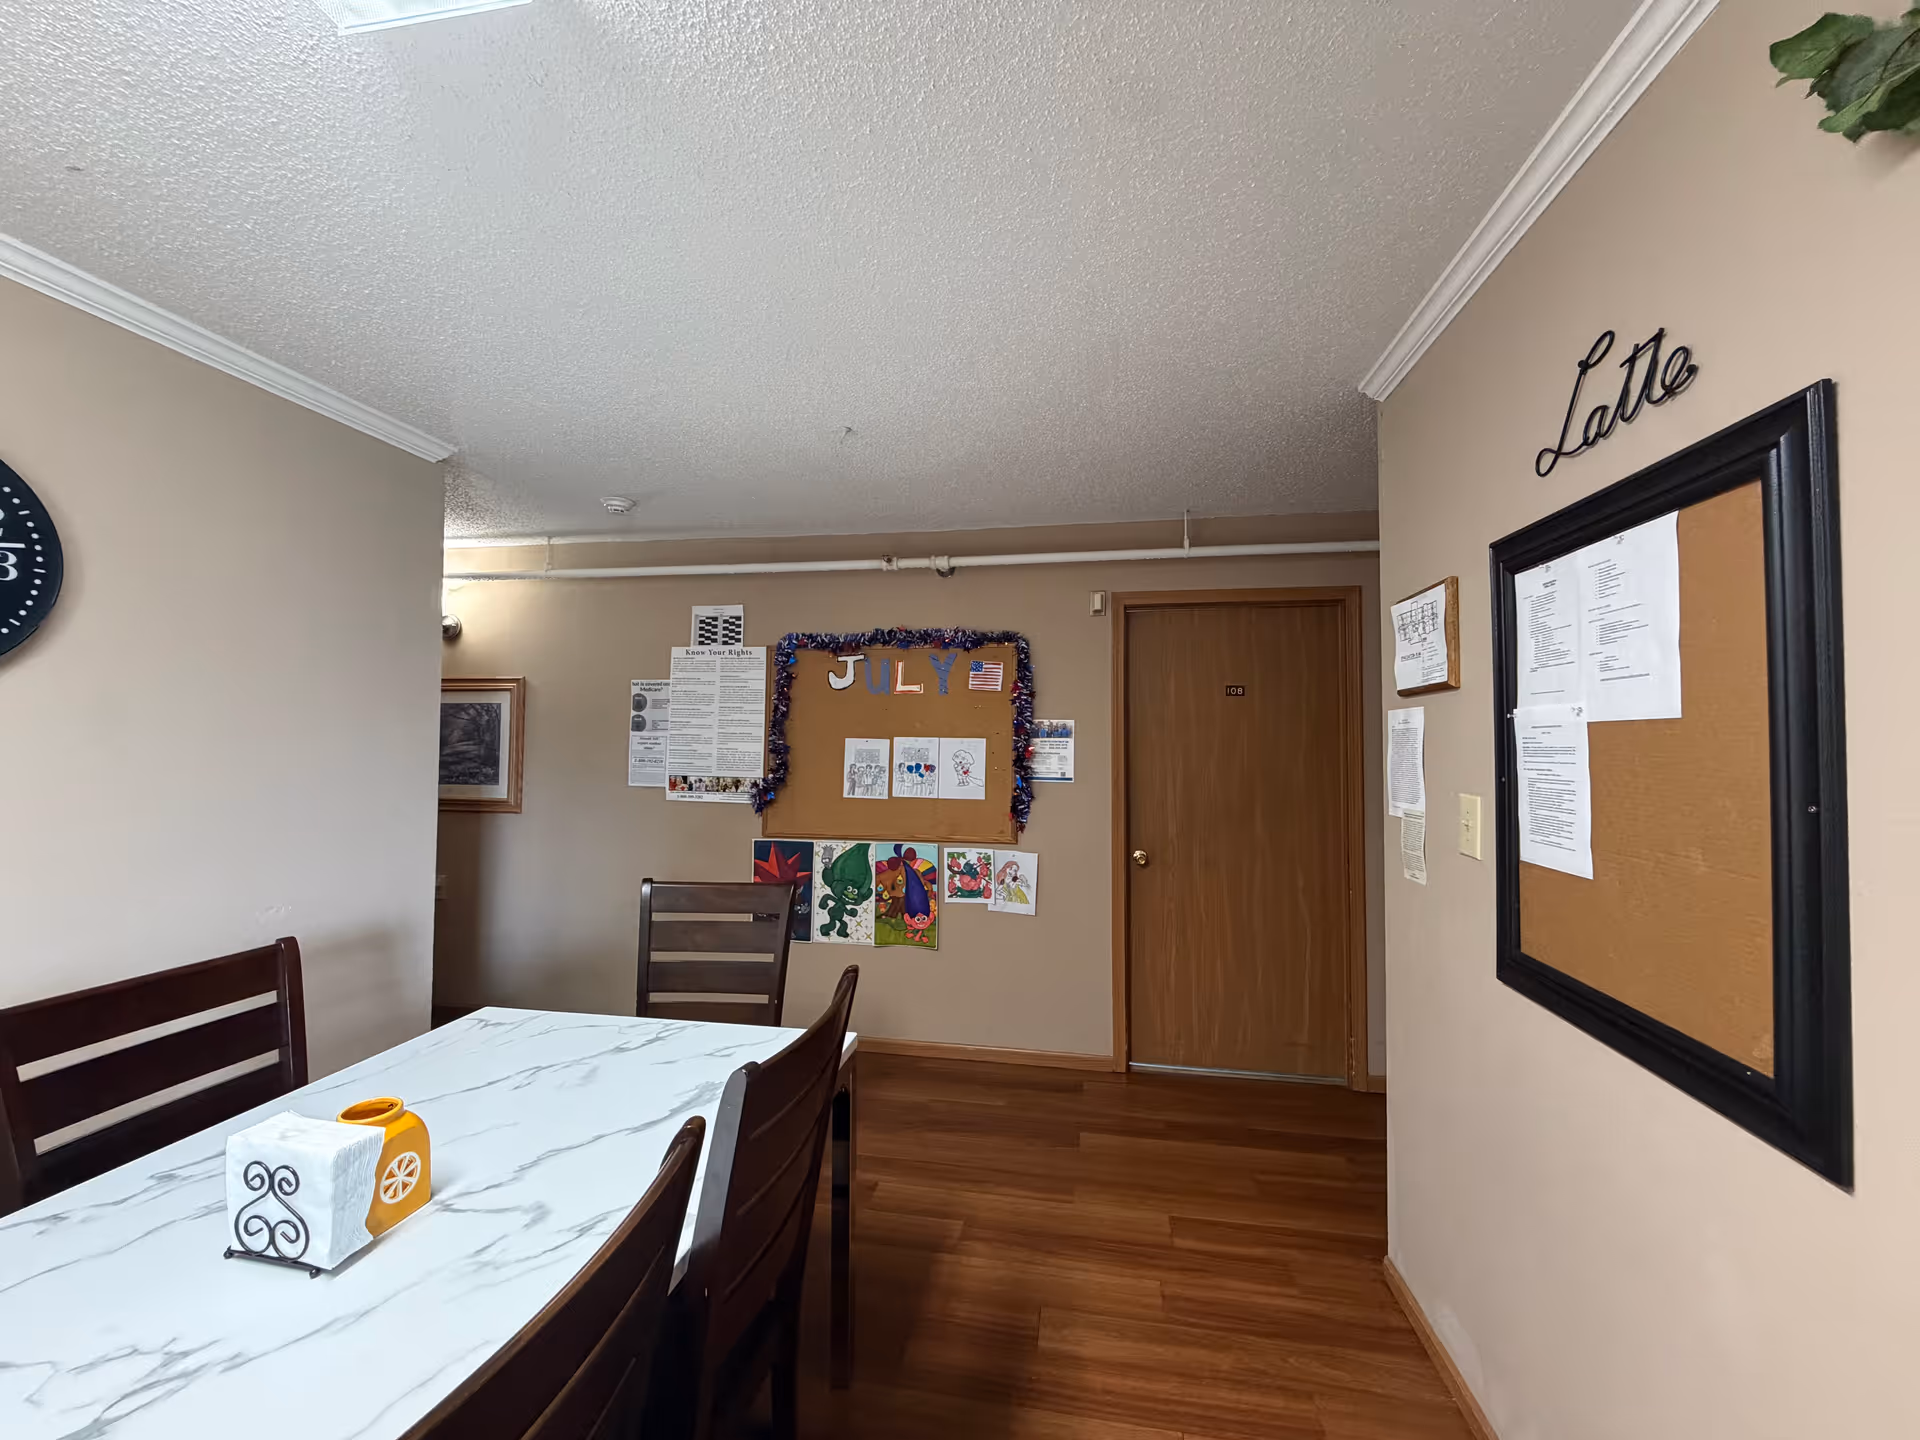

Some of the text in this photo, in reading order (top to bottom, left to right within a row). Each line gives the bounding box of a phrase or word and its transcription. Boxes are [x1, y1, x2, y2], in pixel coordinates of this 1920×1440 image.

[1535, 327, 1698, 477] Latte
[685, 648, 753, 657] Know Your Rights
[827, 652, 957, 696] JULY
[1227, 687, 1243, 695] 108
